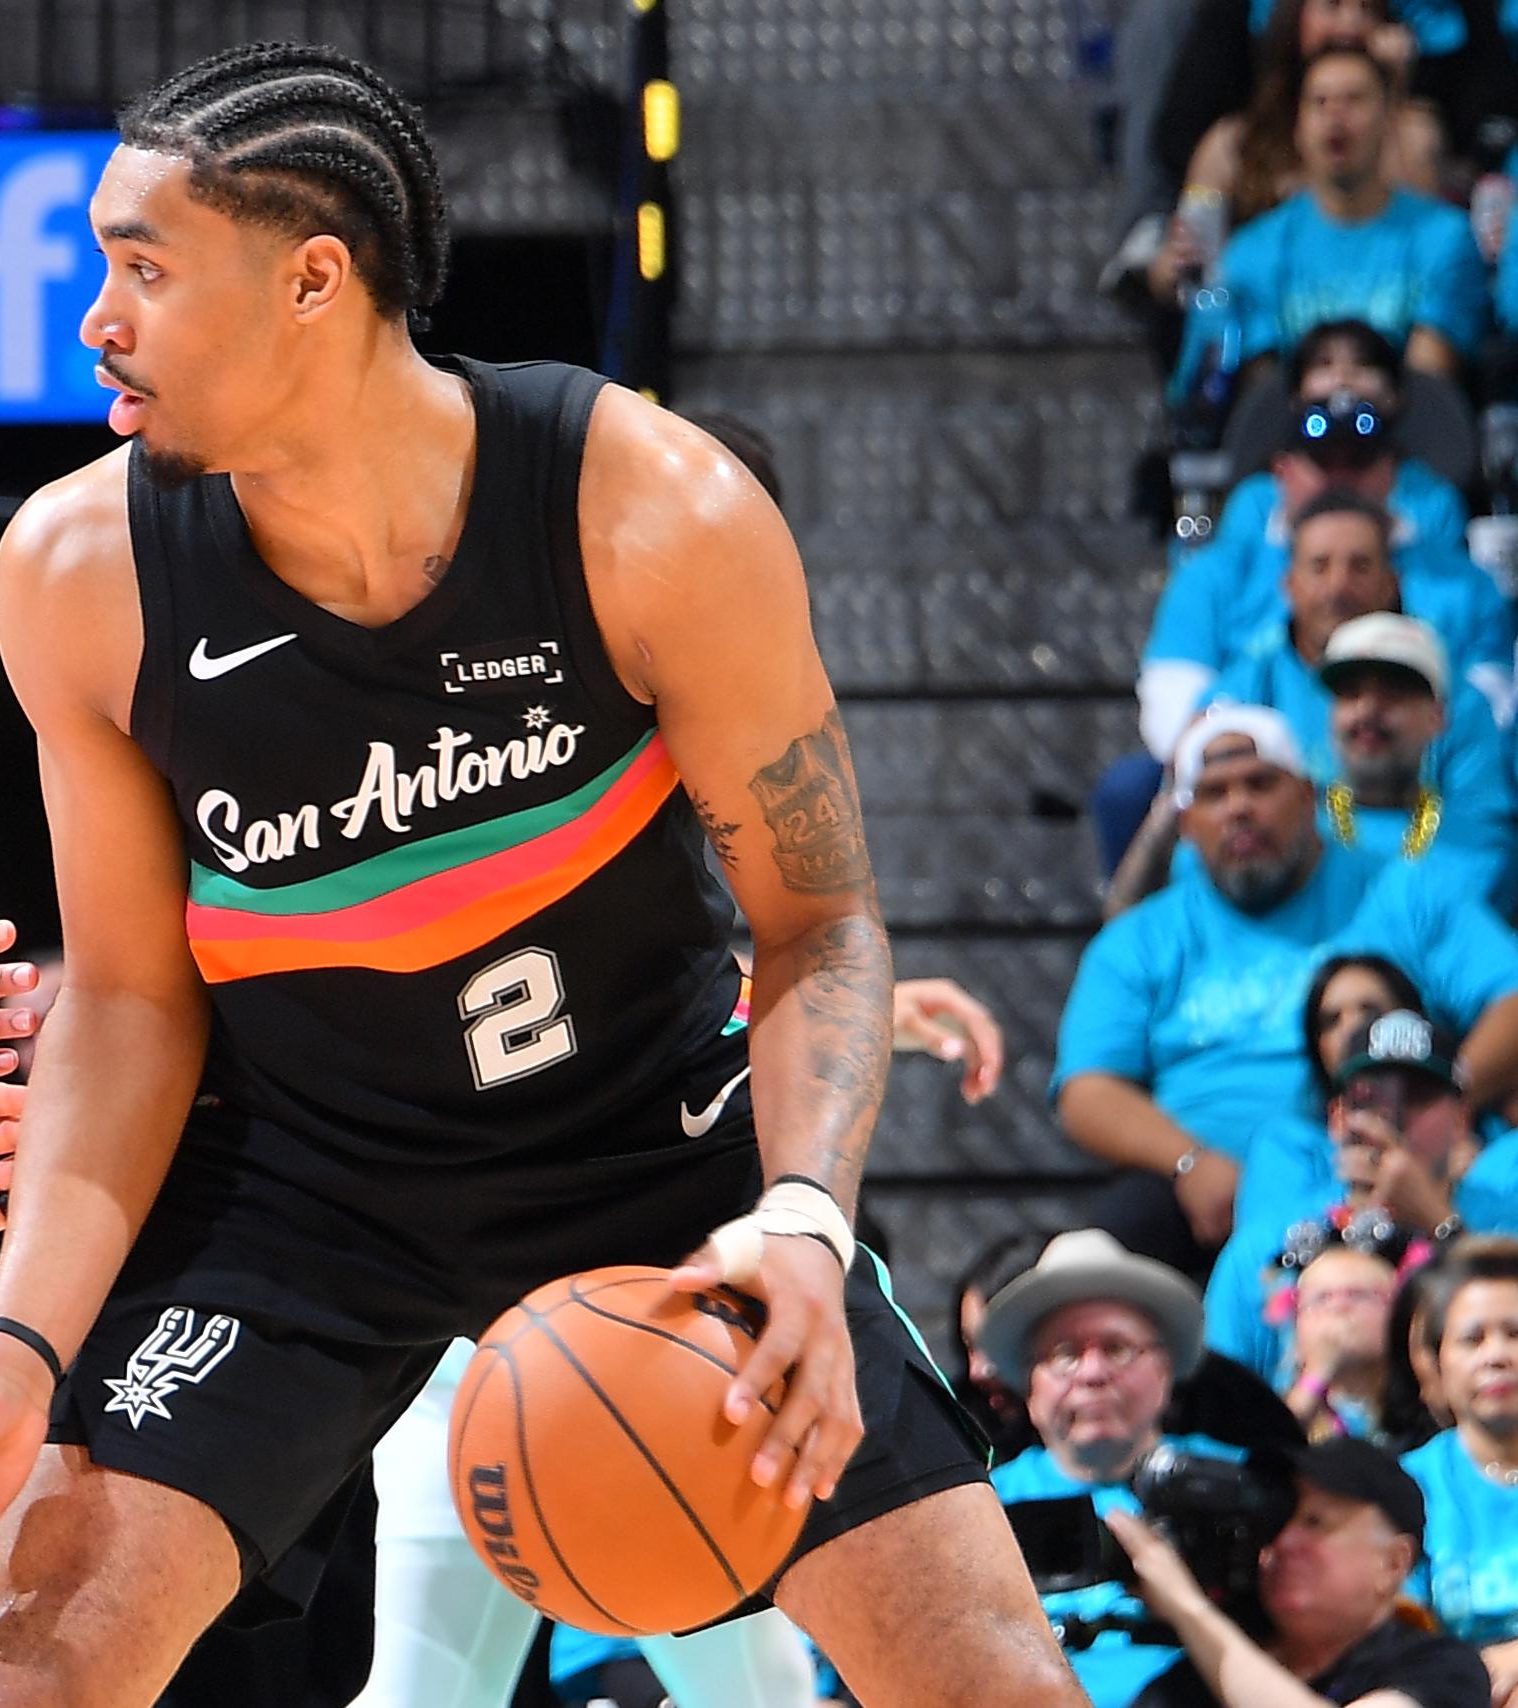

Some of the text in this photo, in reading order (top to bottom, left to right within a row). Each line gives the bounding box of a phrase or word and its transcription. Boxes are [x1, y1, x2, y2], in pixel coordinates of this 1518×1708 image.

[456, 654, 547, 682] LEDGER
[196, 705, 585, 873] San Antonio
[783, 793, 839, 844] 24
[457, 945, 579, 1092] 2
